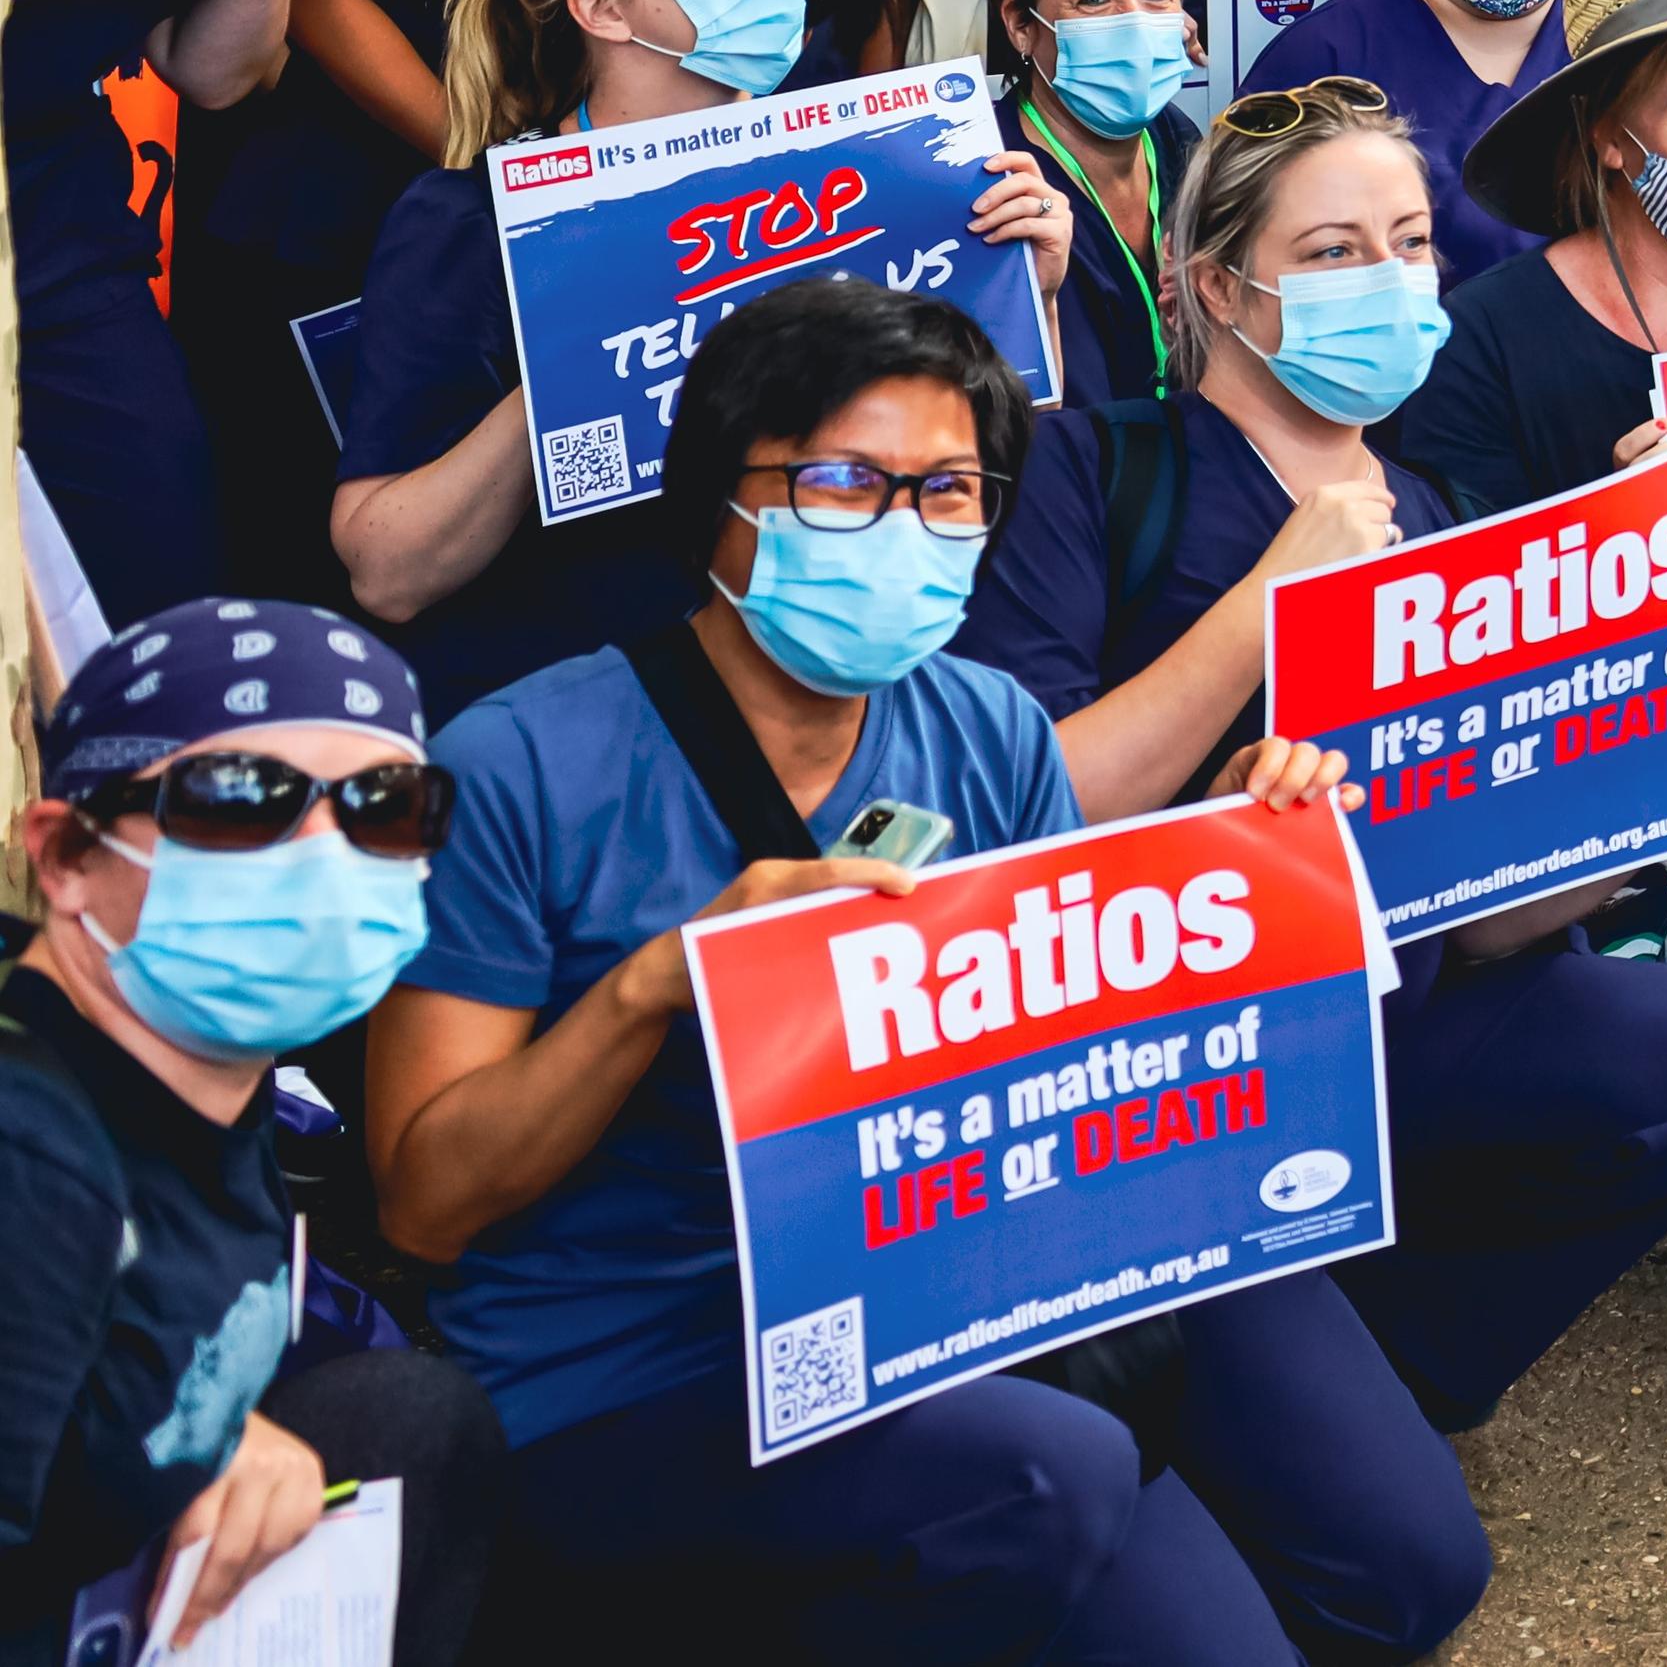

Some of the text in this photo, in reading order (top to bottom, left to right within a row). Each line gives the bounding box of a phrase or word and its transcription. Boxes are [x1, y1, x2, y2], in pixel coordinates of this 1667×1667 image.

[828, 869, 1255, 1072] Ratios
[856, 1006, 1259, 1178] It's a matter of
[862, 1069, 1268, 1250] LIFE or DEATH
[873, 1245, 1229, 1386] www.ratioslifeordeath.org.au
